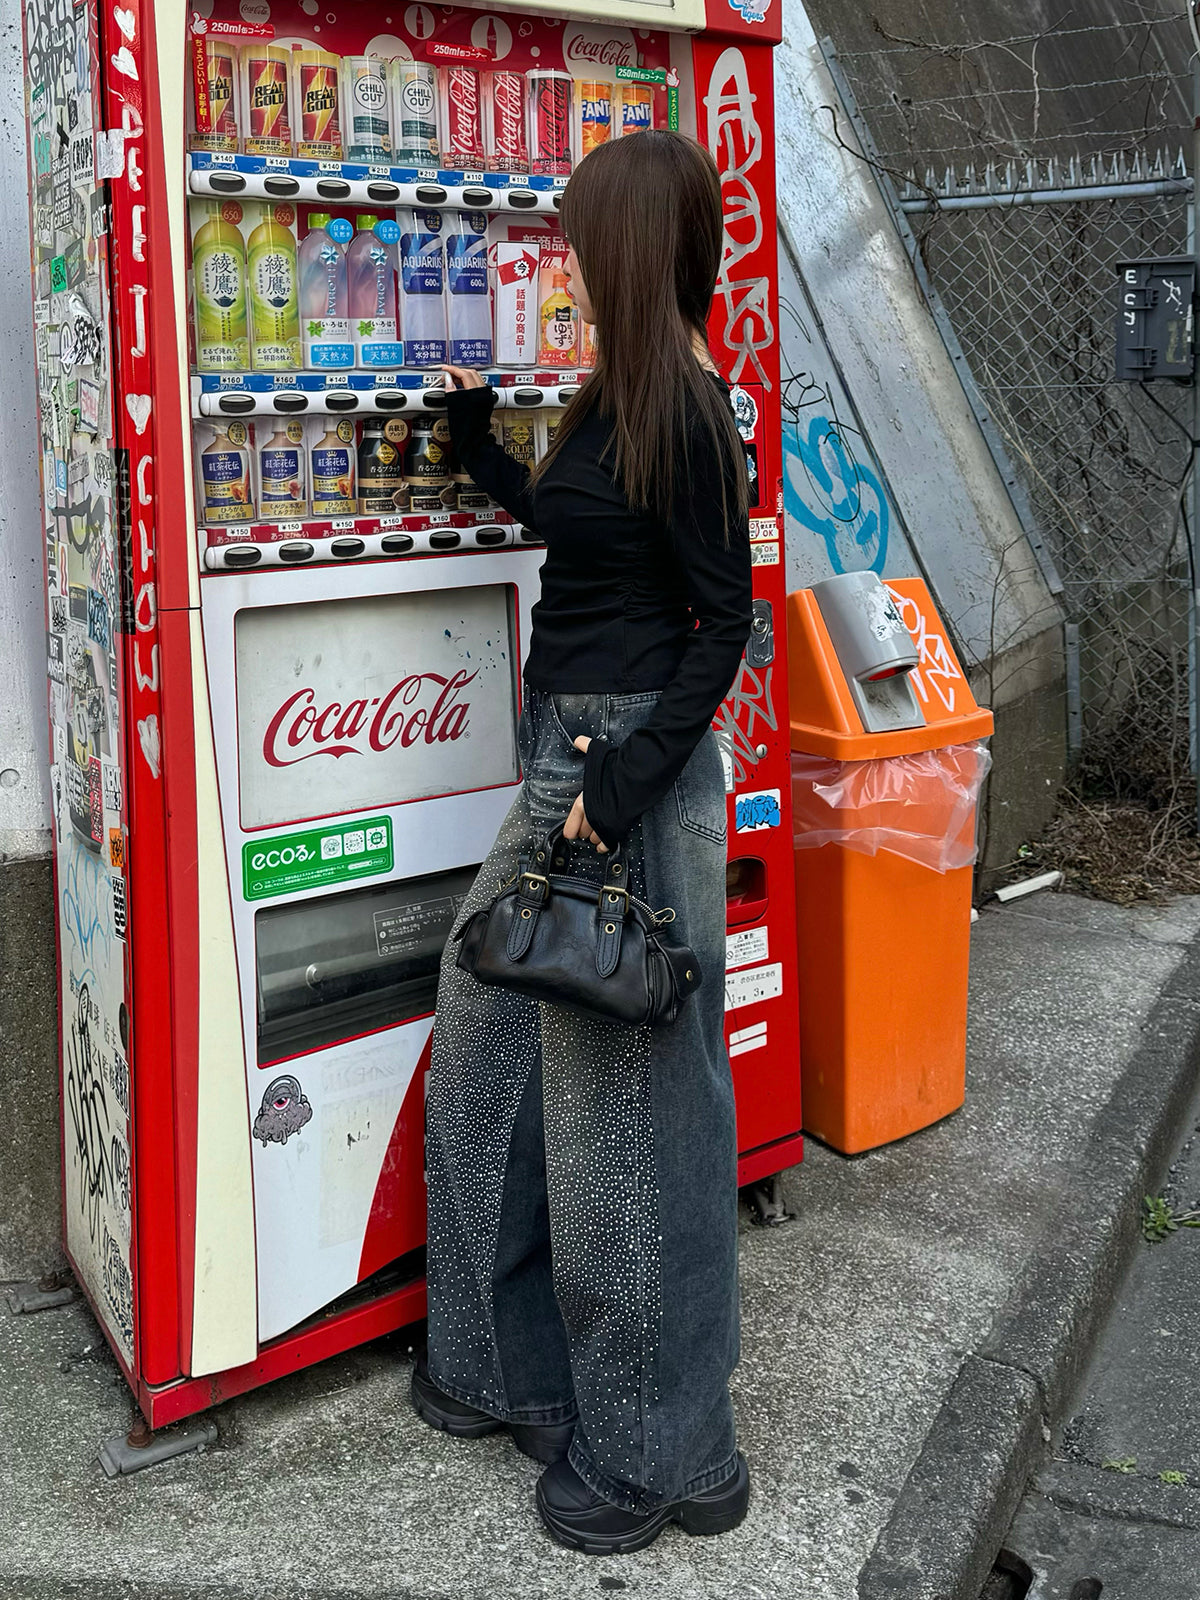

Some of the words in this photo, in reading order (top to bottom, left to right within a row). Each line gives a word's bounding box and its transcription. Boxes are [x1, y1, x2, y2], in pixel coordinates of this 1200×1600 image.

[568, 34, 633, 66] Coca-Cola
[209, 76, 230, 90] EAL
[255, 81, 284, 96] REAL
[307, 87, 335, 102] REAL
[358, 84, 384, 94] CHILL
[407, 88, 431, 99] CHILL
[255, 94, 284, 108] GOLD
[362, 94, 383, 103] OUT
[410, 97, 430, 106] OUT
[307, 99, 335, 113] GOLD
[214, 155, 233, 163] ¥140
[269, 158, 288, 166] ¥140
[403, 255, 443, 268] AQUARIUS
[448, 256, 488, 269] AQUARIUS
[211, 252, 234, 295] 綾鷹
[517, 263, 526, 273] 今
[265, 253, 288, 296] 綾鷹
[554, 323, 568, 347] ゆず
[320, 352, 349, 361] 天然水
[370, 351, 398, 361] 天然水
[222, 376, 241, 384] ¥160
[276, 376, 294, 384] ¥160
[208, 460, 240, 472] 紅茶花伝
[265, 458, 296, 469] 紅茶花伝
[318, 458, 347, 467] 紅茶花伝
[230, 528, 249, 536] ¥150
[762, 529, 774, 537] OK
[46, 523, 57, 589] VELK
[262, 667, 481, 768] Coca-Cola
